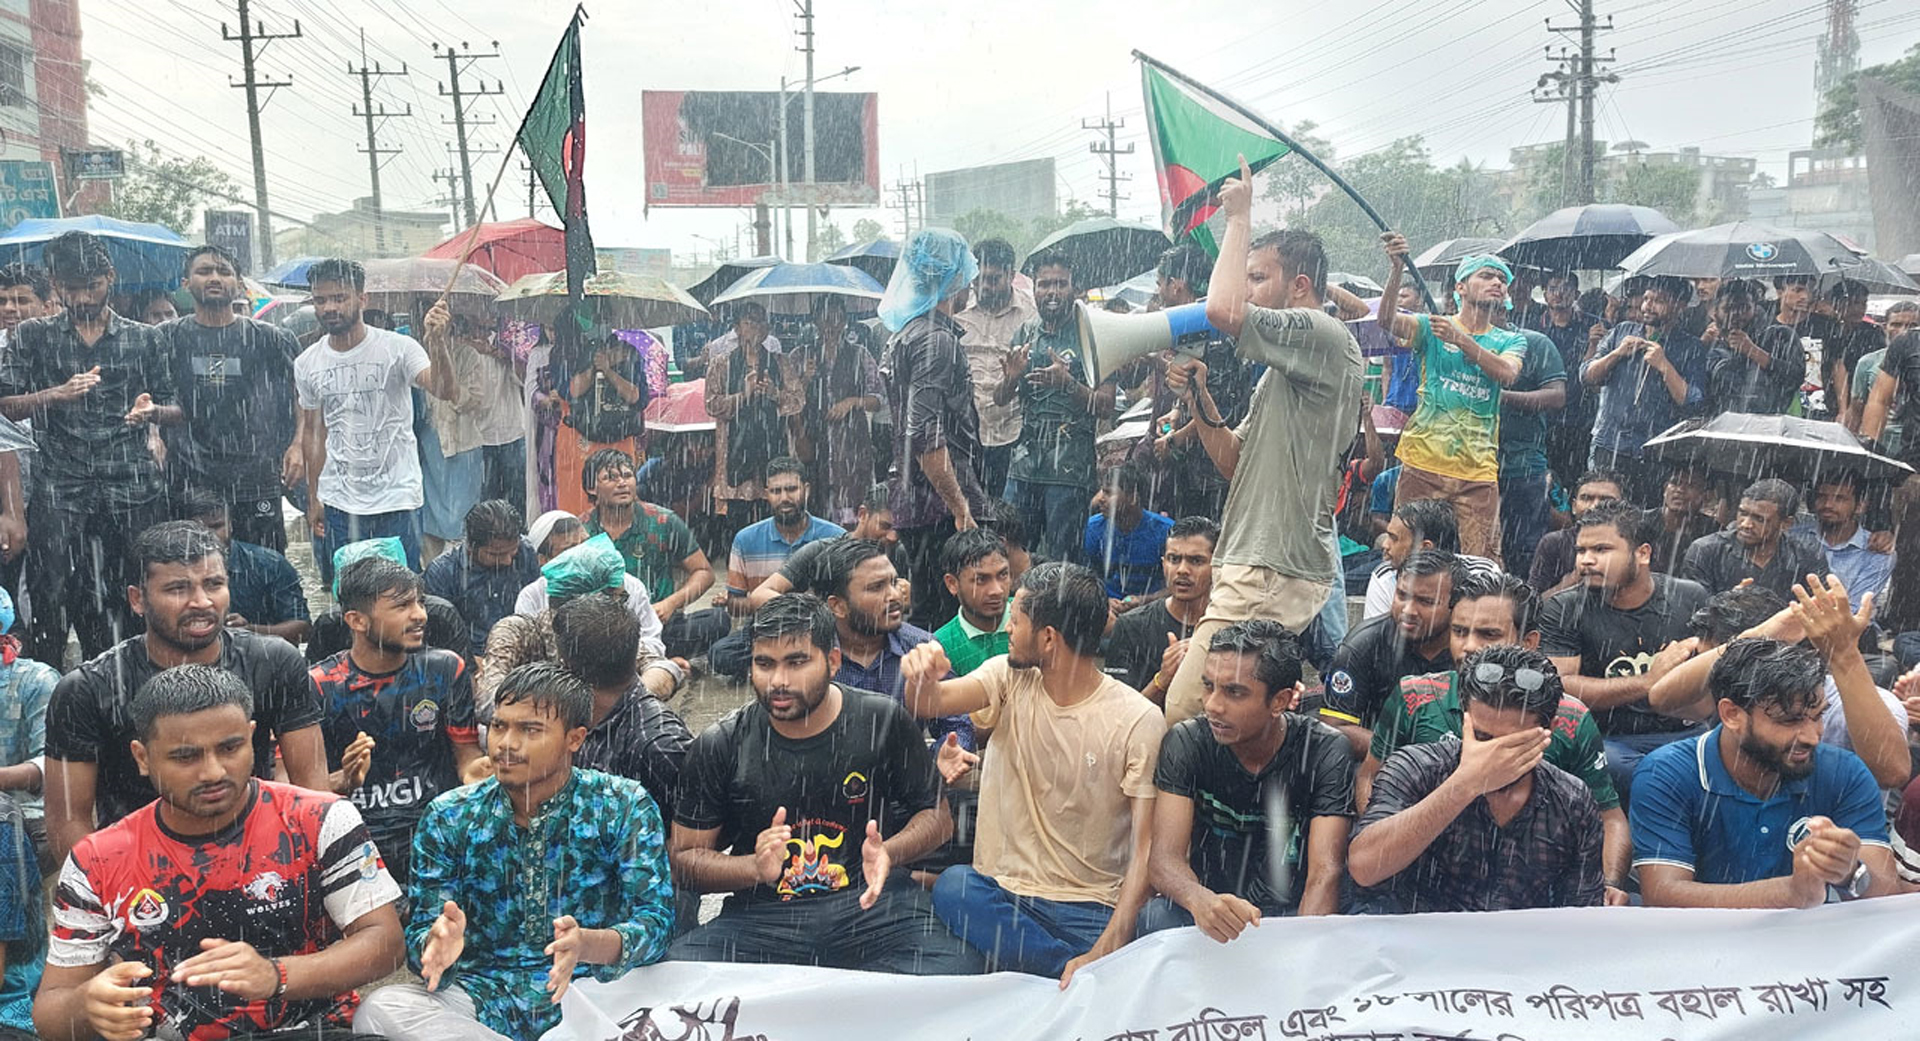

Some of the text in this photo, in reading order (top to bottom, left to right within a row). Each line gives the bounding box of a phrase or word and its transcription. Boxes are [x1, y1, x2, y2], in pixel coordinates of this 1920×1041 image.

[215, 224, 247, 237] ATM
[246, 899, 291, 915] WOLVES
[1166, 1006, 1268, 1041] বাতিল
[1280, 1005, 1346, 1038] এবং
[1525, 985, 1644, 1020] পরিপত্র
[1648, 985, 1746, 1021] বহাল
[1750, 977, 1829, 1014] রাখা
[1837, 976, 1893, 1011] সহ
